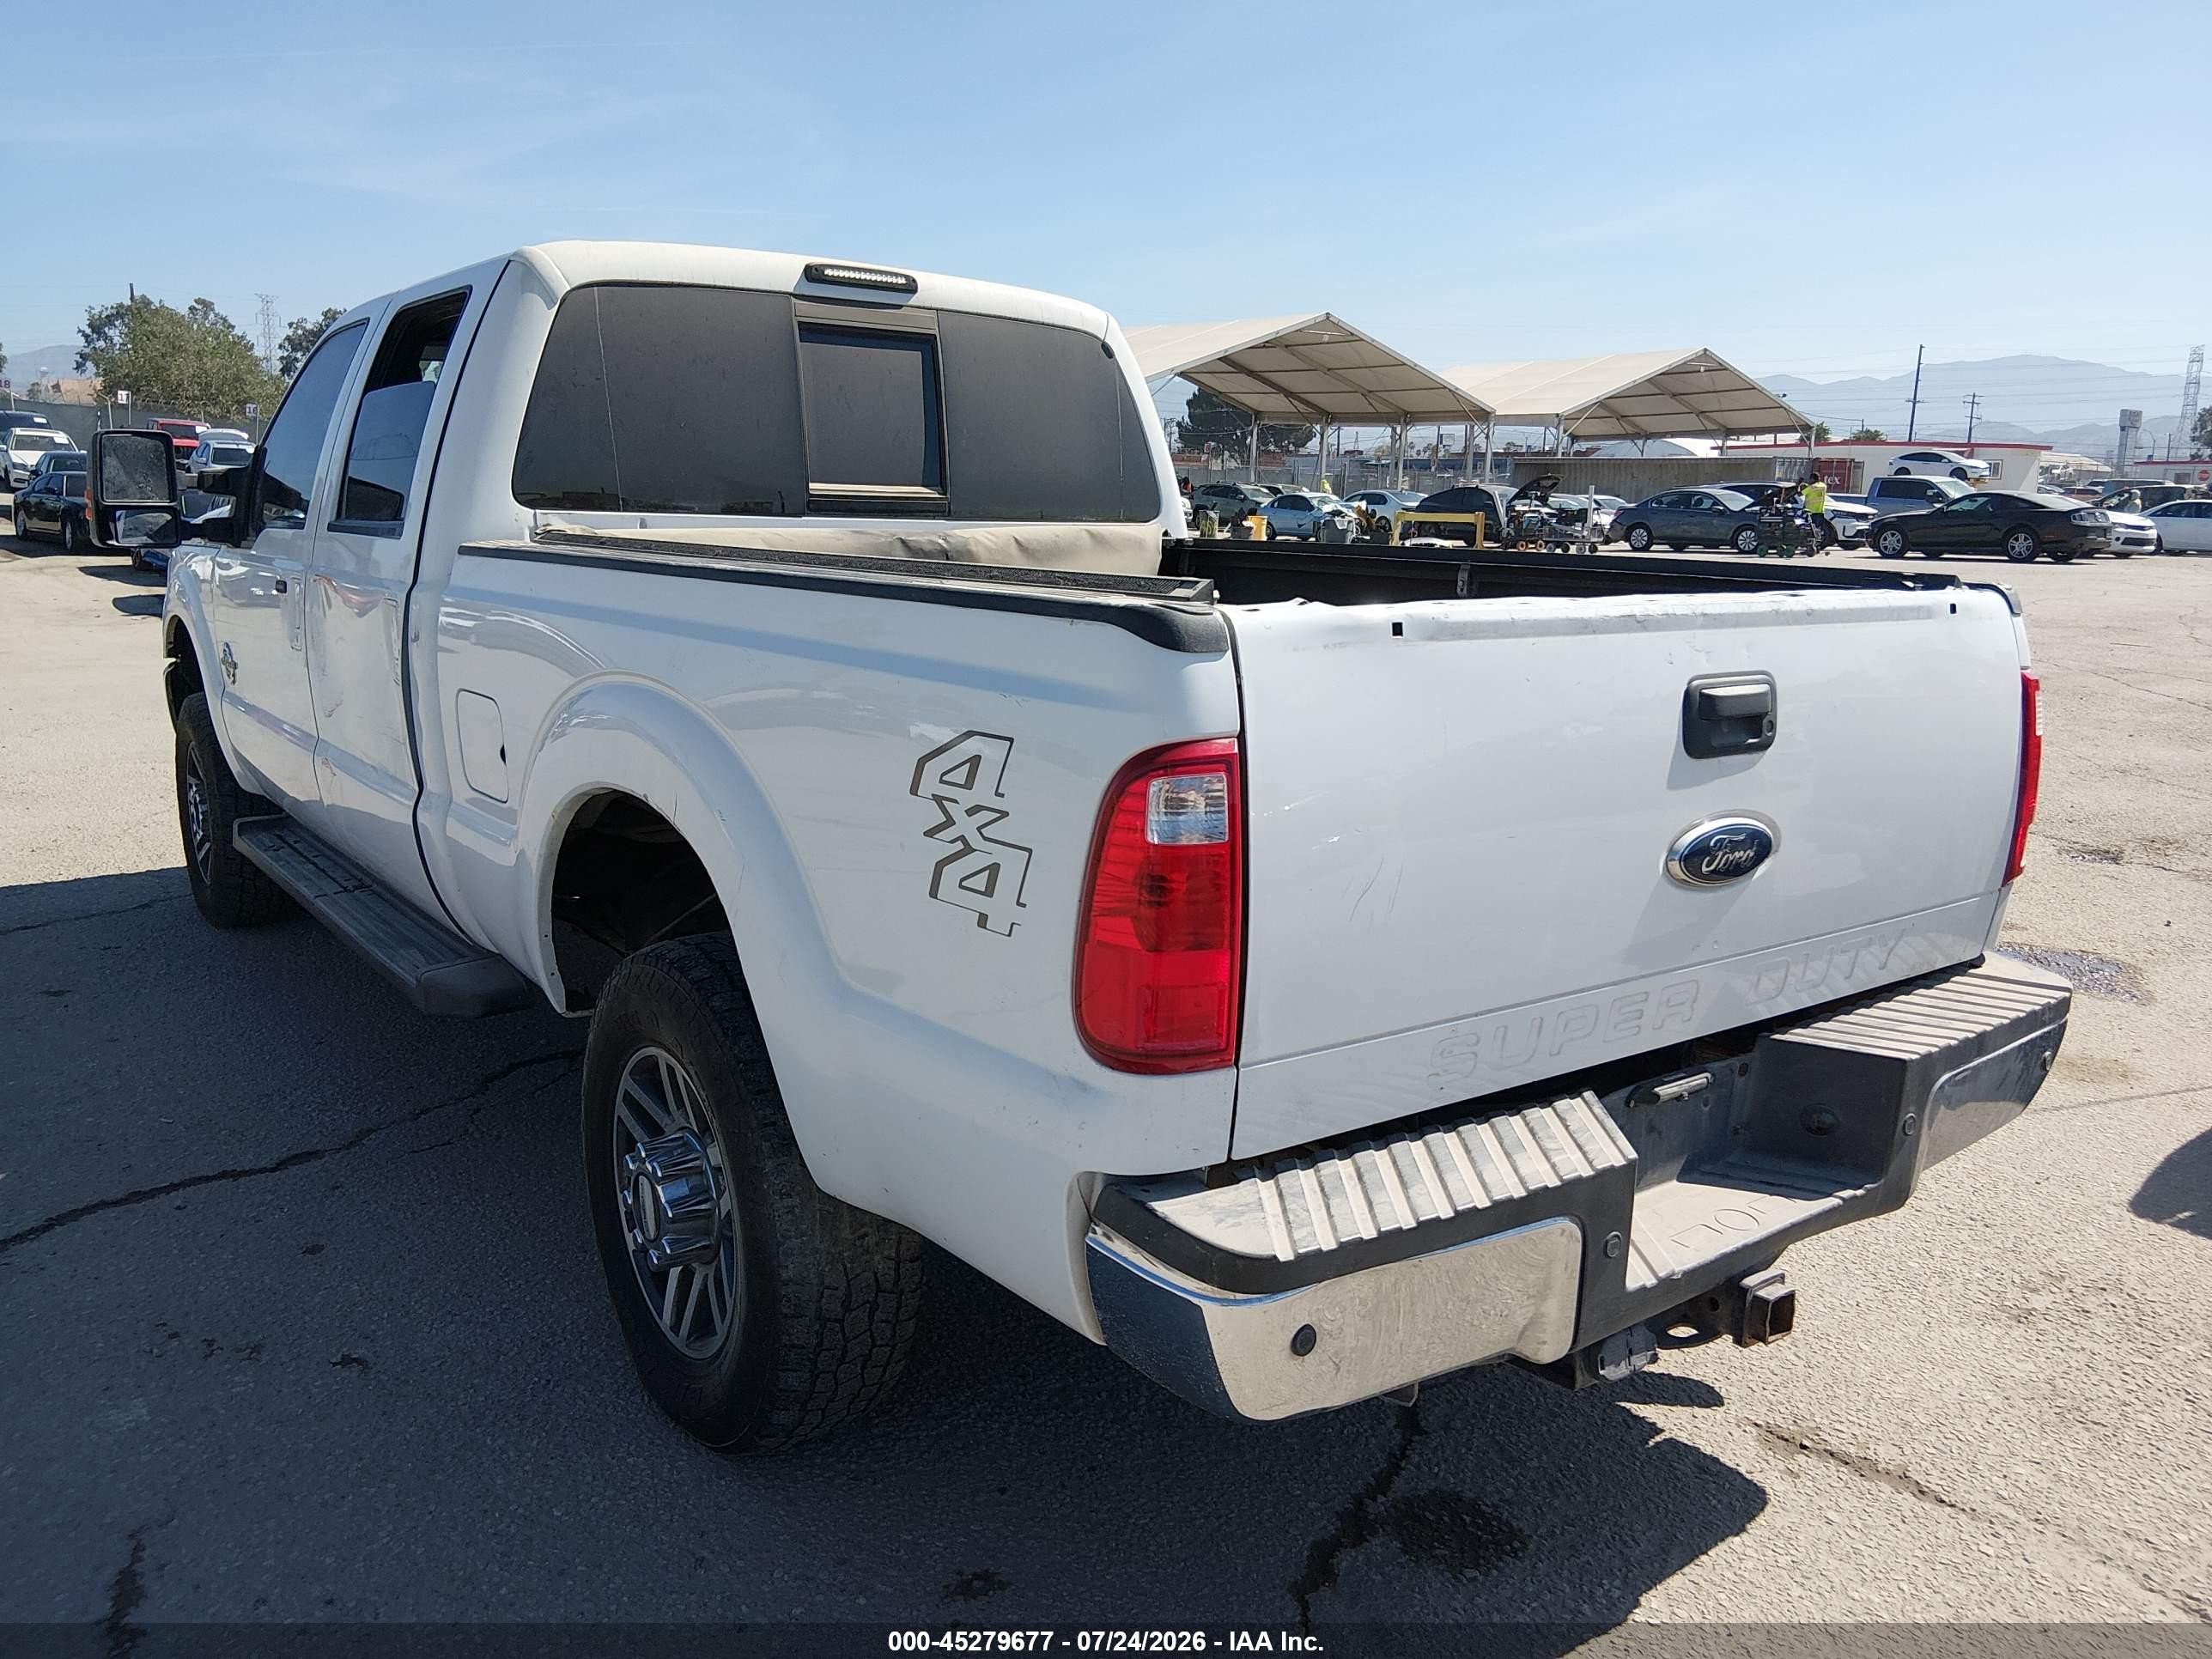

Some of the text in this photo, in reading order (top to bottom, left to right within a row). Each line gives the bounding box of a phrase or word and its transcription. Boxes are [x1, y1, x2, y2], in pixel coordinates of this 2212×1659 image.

[1701, 833, 1759, 875] Ford
[1426, 928, 1905, 1079] SUPER DUTY
